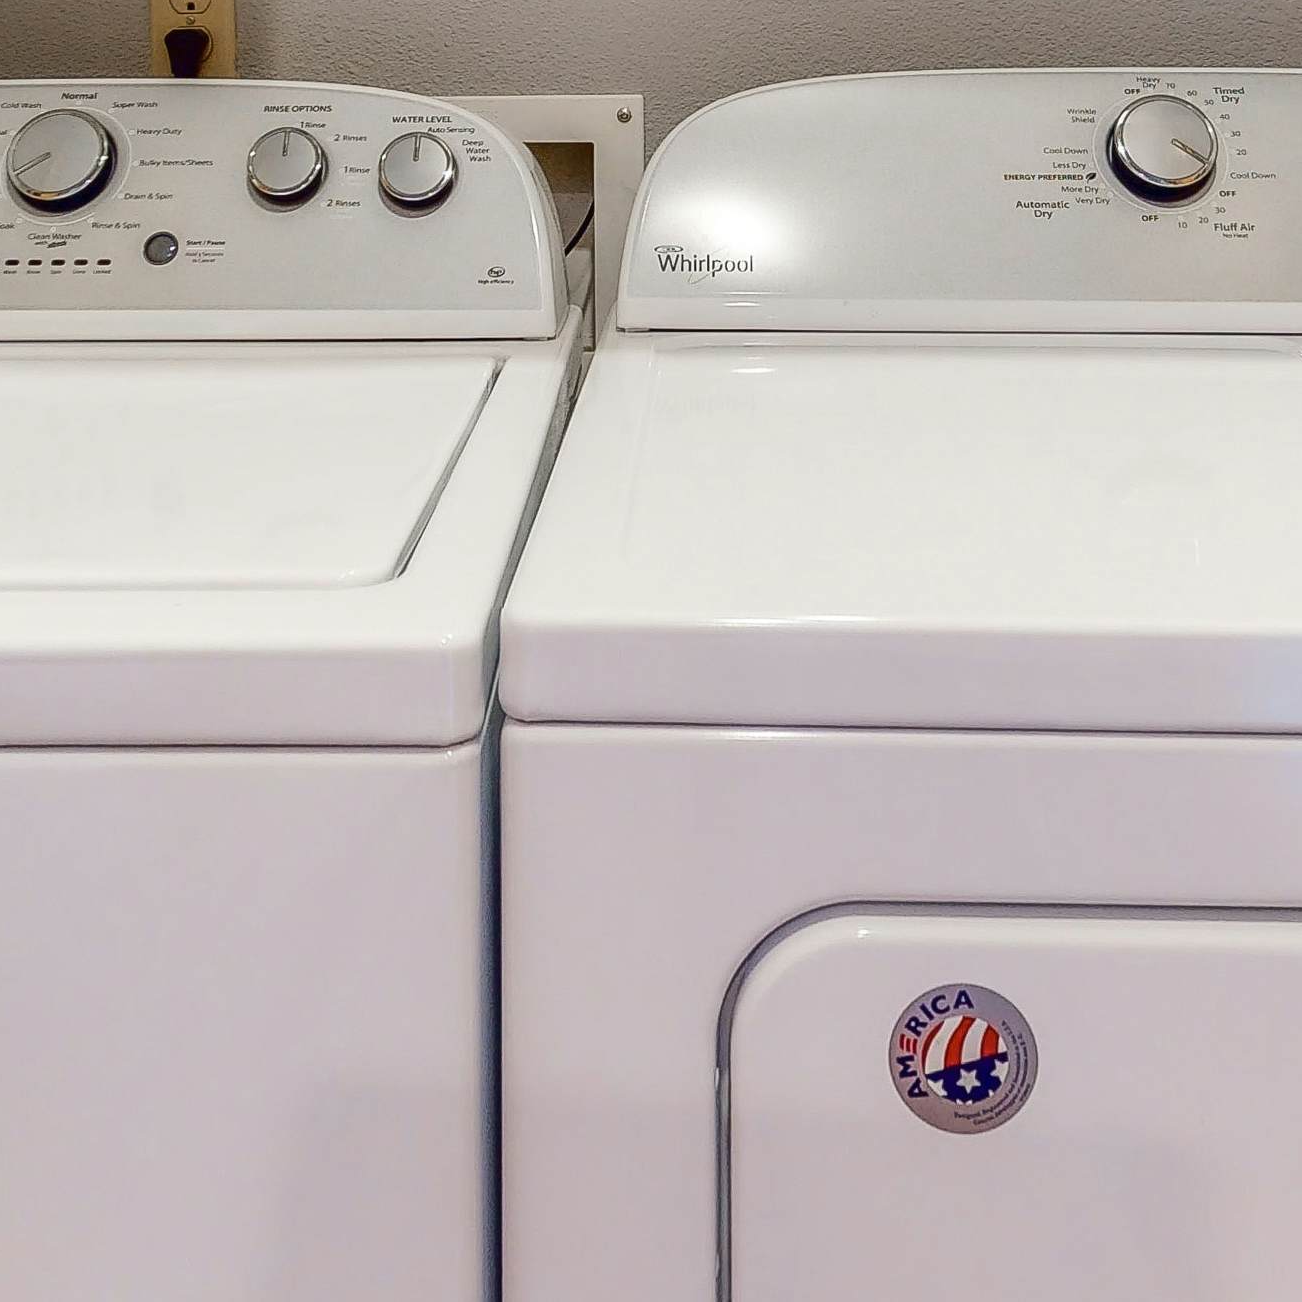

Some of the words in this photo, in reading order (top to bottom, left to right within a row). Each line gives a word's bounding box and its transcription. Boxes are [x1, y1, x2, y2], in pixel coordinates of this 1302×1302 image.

[1142, 82, 1156, 90] Dry
[1213, 87, 1245, 95] Timed
[61, 92, 98, 100] Normal
[1221, 96, 1240, 104] Dry
[136, 128, 162, 136] Heavy
[162, 128, 182, 136] Duty
[427, 126, 446, 134] Auto
[446, 126, 475, 134] Sensing
[334, 134, 340, 142] 2
[342, 134, 368, 142] Rinses
[1072, 162, 1086, 170] Dry
[1230, 172, 1250, 180] Cool
[1250, 172, 1276, 180] Down
[1084, 186, 1099, 194] Dry
[1218, 190, 1236, 198] OFF
[1016, 200, 1070, 209] Automatic
[1095, 197, 1110, 206] Dry
[1215, 206, 1226, 214] 30
[1034, 210, 1053, 220] Dry
[1141, 214, 1159, 222] OFF
[1198, 216, 1209, 224] 20
[122, 222, 141, 230] Spin
[1214, 222, 1237, 232] Fluff
[1240, 222, 1256, 232] Air
[657, 254, 754, 278] Whirlpool
[896, 990, 974, 1098] AMERICA
